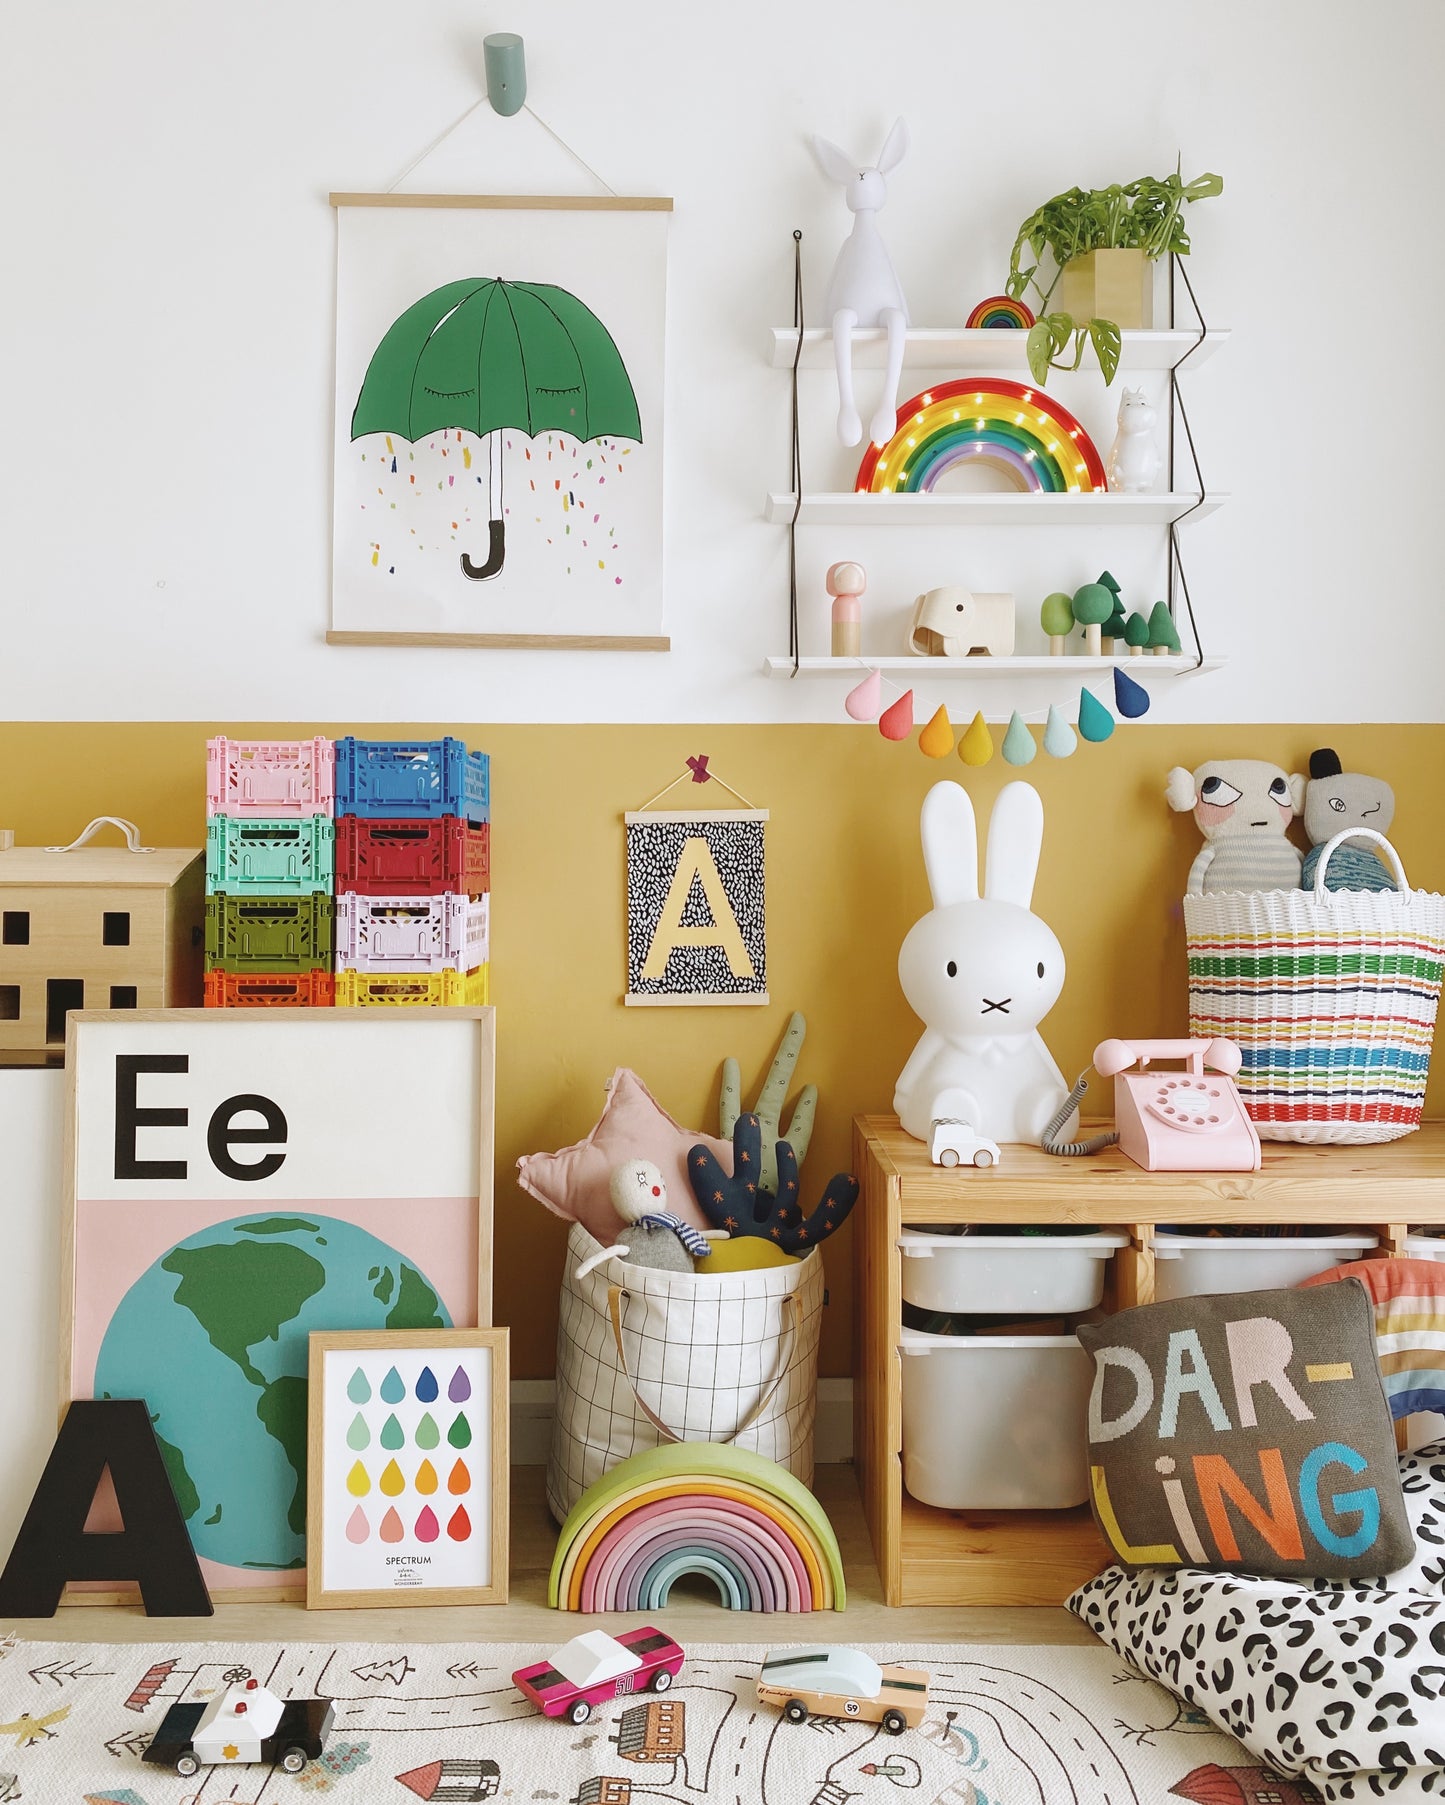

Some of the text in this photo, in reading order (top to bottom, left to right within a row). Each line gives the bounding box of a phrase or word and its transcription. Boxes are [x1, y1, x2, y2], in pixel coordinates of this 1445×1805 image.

[640, 837, 756, 979] A
[115, 1055, 289, 1181] Ee
[1089, 1317, 1353, 1443] DAR-
[0, 1399, 214, 1618] A
[385, 1556, 432, 1565] SPECTRUM
[615, 1673, 635, 1697] 50
[847, 1703, 858, 1713] 59
